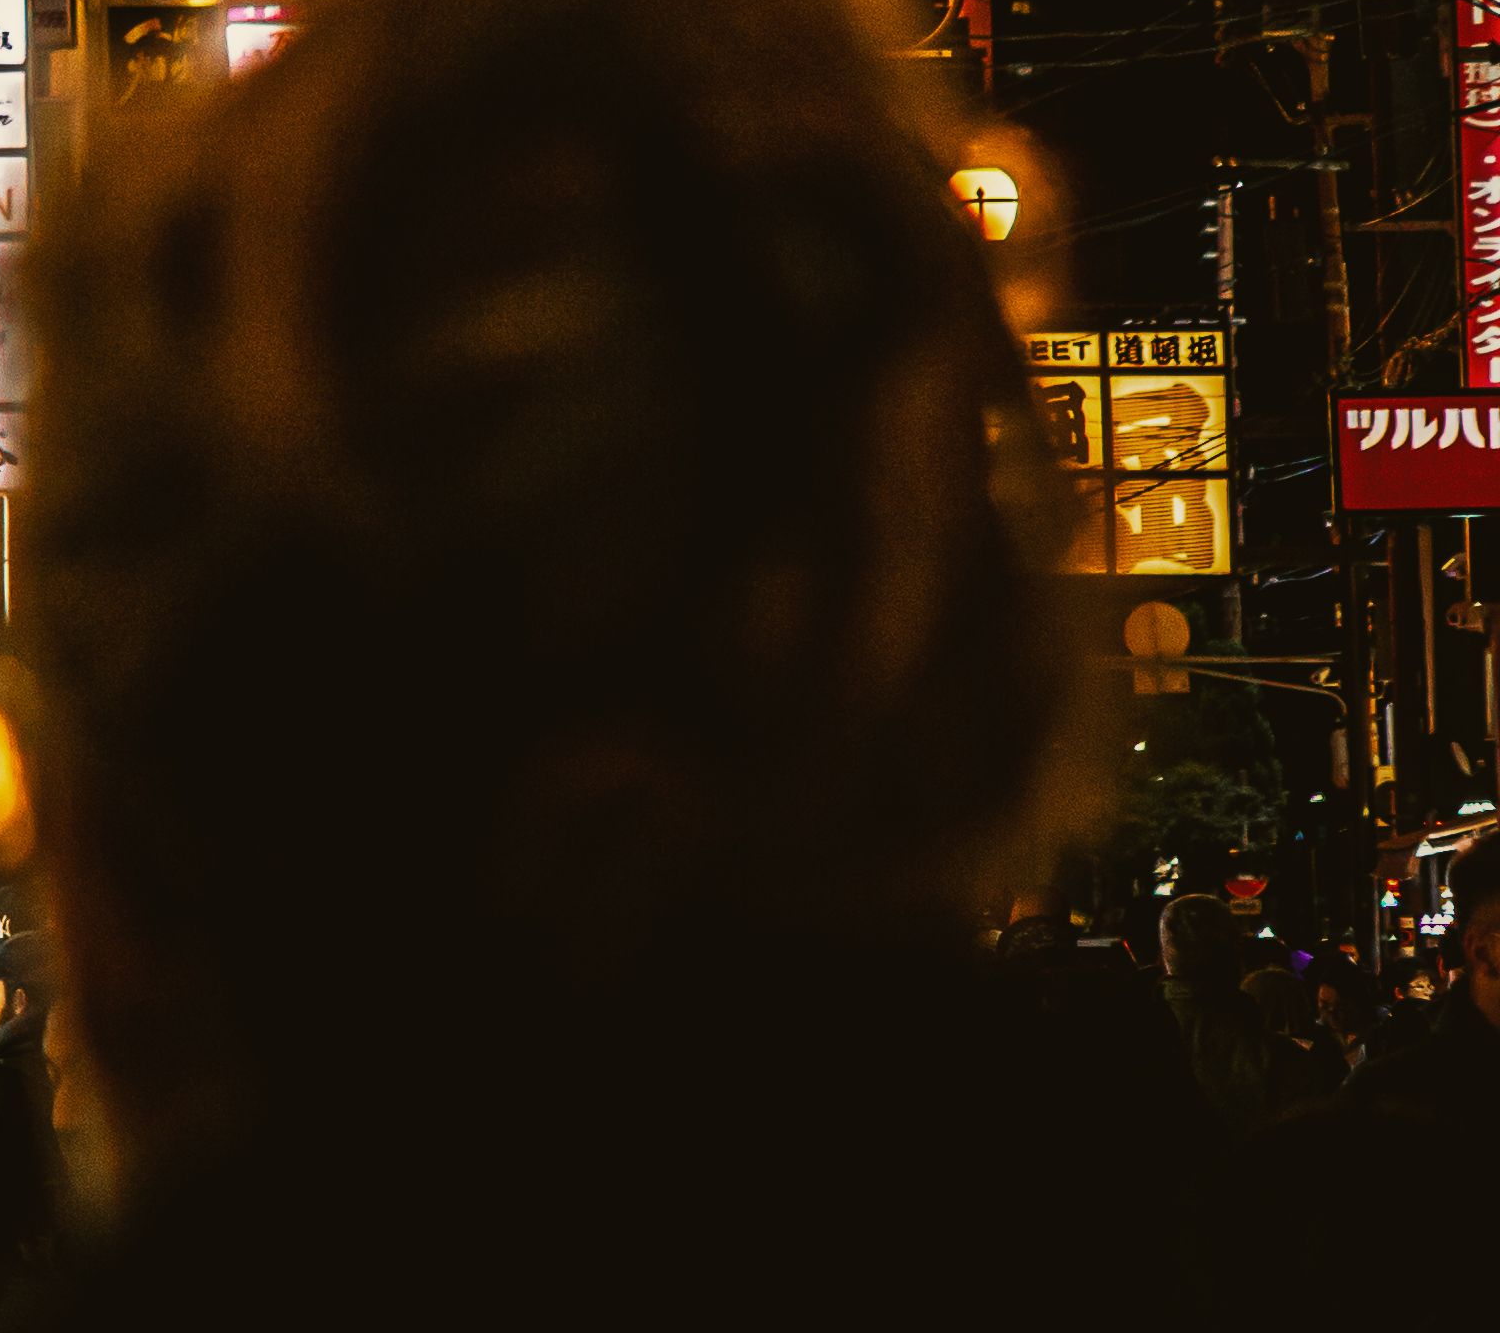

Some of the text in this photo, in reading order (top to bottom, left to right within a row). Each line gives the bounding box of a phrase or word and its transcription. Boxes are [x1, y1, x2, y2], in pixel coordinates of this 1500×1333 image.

[1029, 339, 1092, 362] EET
[1114, 334, 1219, 367] 道頓堀
